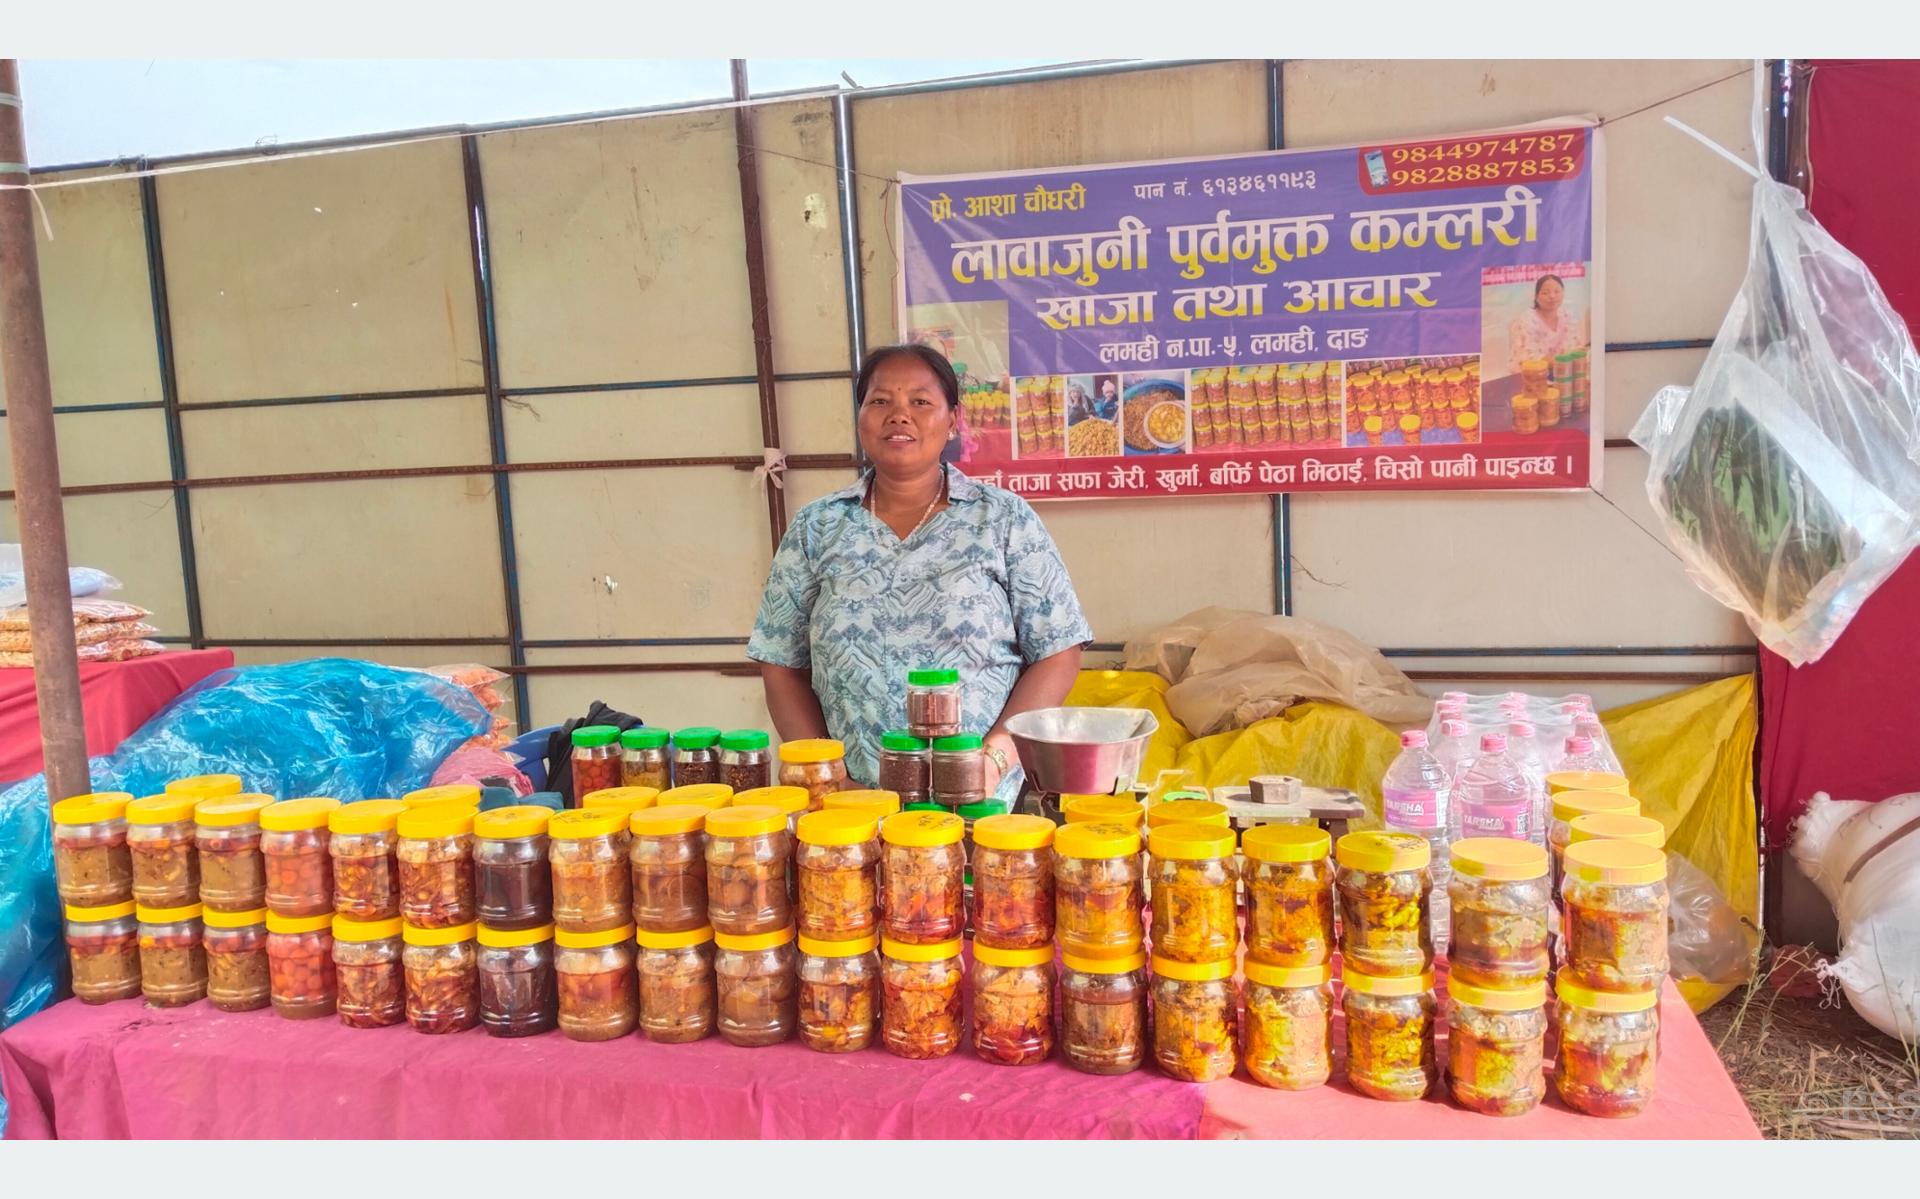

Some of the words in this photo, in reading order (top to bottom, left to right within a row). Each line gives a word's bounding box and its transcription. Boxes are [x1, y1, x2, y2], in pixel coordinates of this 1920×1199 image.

[1391, 133, 1575, 164] 9844974787
[1133, 182, 1166, 200] पान
[1173, 177, 1192, 197] नं.
[1202, 169, 1317, 197] ६१३४६११९३
[1391, 156, 1576, 187] 9828887853
[930, 193, 957, 223] प्रो.
[964, 192, 1016, 218] आशा
[1024, 182, 1087, 212] चौधरी
[951, 215, 1152, 287] लावाजुनी
[1166, 209, 1335, 280] पुर्वमुक्त
[1350, 184, 1543, 254] कम्लरी
[1036, 290, 1158, 331] खाजा
[1172, 282, 1268, 324] तथा
[1283, 271, 1442, 316] आचार
[1099, 337, 1160, 364] लमही
[1326, 327, 1370, 352] दाङ
[1008, 473, 1052, 492] ताजा
[1057, 472, 1102, 492] सफा
[1259, 459, 1297, 485] पेठा
[1374, 453, 1425, 481] चिसो
[1430, 453, 1478, 479] पानी
[1484, 455, 1558, 480] पाइन्छ
